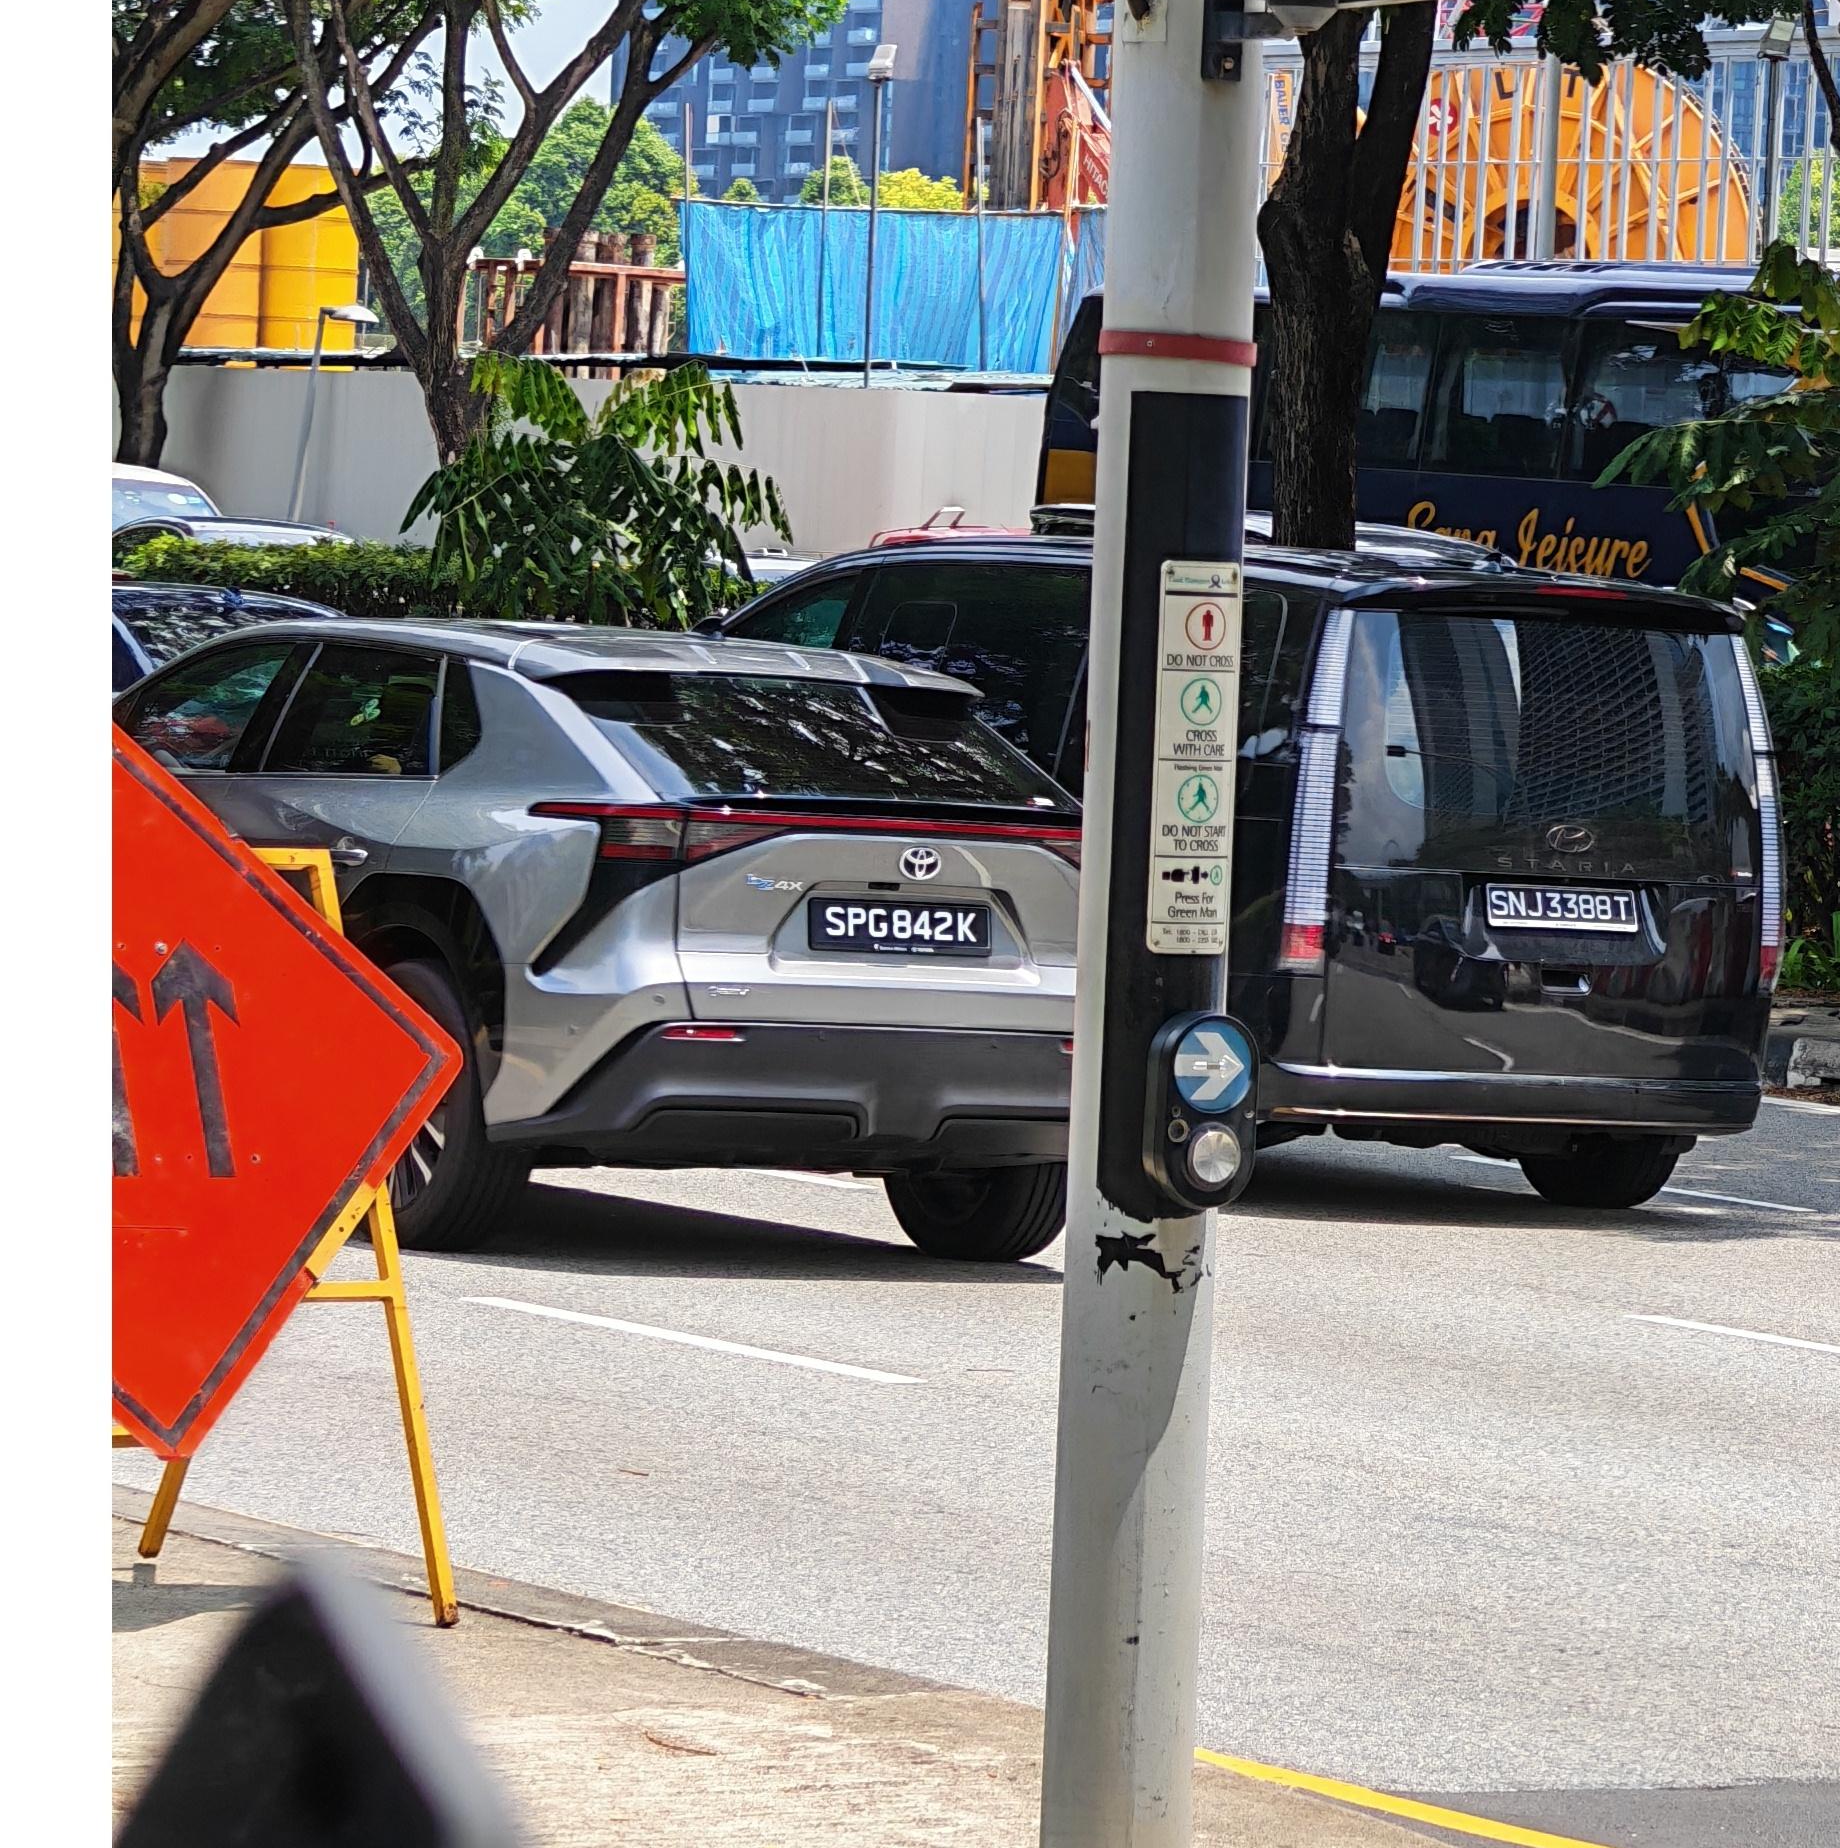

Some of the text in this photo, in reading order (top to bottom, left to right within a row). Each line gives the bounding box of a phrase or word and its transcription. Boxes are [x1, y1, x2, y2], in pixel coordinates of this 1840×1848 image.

[1274, 80, 1291, 126] BAUER
[1166, 654, 1234, 667] DO NOT CROSS
[1186, 730, 1217, 742] CROSS
[1173, 743, 1225, 756] WITH CARE
[1162, 824, 1226, 837] DO NOT START
[1173, 839, 1218, 852] TO CROSS
[1497, 857, 1636, 873] STARIA
[1175, 892, 1214, 904] Press For
[1168, 906, 1217, 918] Green Man
[1491, 890, 1629, 921] SNJ3388T
[825, 906, 977, 943] SPG842K
